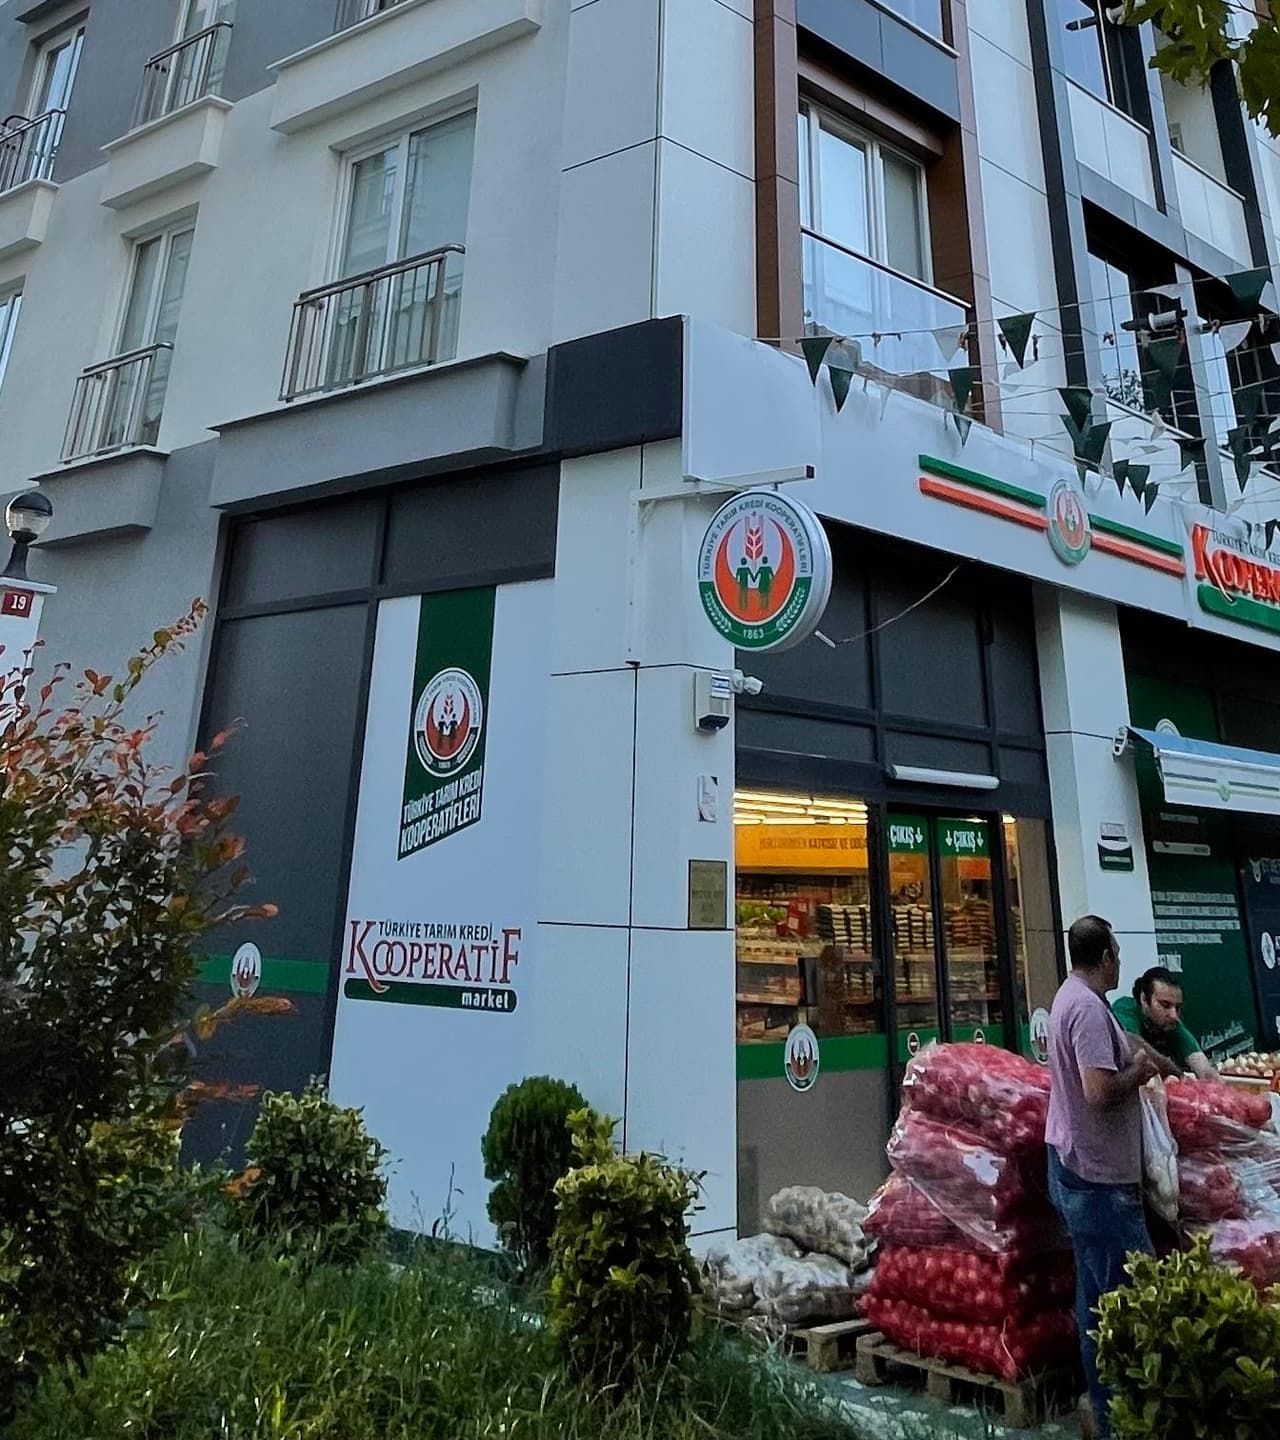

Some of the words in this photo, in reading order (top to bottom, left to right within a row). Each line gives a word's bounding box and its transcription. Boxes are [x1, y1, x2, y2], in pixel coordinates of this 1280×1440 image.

[716, 507, 738, 530] TARIM
[739, 499, 764, 512] KREDİ
[11, 594, 27, 610] 19
[743, 628, 765, 639] 1863
[404, 792, 434, 824] TÜRKİYE
[435, 779, 459, 809] TARIM
[459, 765, 483, 798] KREDİ
[400, 787, 481, 853] KOOPERATİFLERİ
[890, 825, 914, 849] ÇIKIŞ
[953, 830, 976, 852] ÇIKIŞ
[379, 918, 420, 938] TÜRKİYE
[423, 923, 457, 939] TARIM
[460, 922, 493, 942] KREDİ
[346, 920, 521, 993] KOOPERATİF
[461, 989, 509, 1009] market
